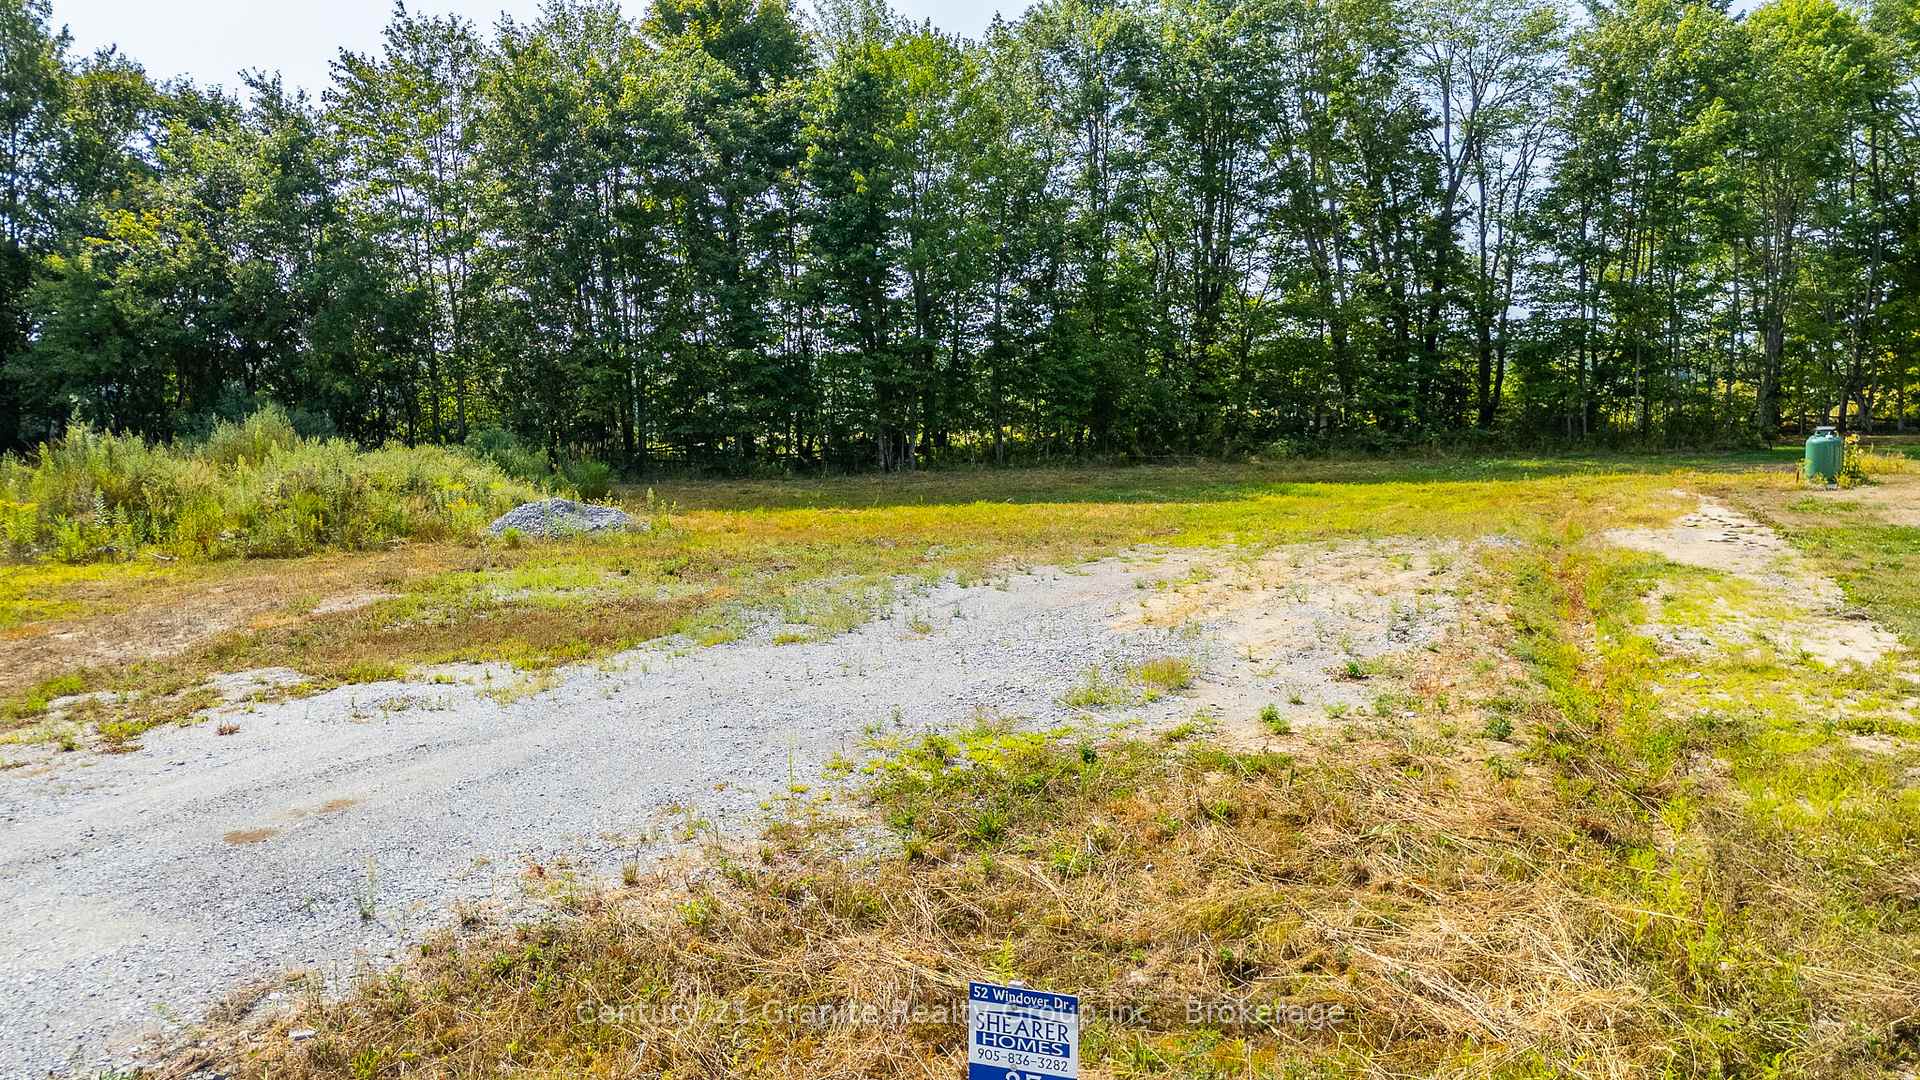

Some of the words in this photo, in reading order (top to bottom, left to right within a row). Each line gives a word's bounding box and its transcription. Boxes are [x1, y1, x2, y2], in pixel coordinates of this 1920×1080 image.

[973, 986, 989, 999] 52
[992, 988, 1049, 1007] Windover
[1054, 997, 1073, 1010] Dr.
[976, 1012, 1070, 1043] SHEARER
[982, 1032, 1064, 1056] HOMES
[977, 1048, 1068, 1072] 905-836-3282
